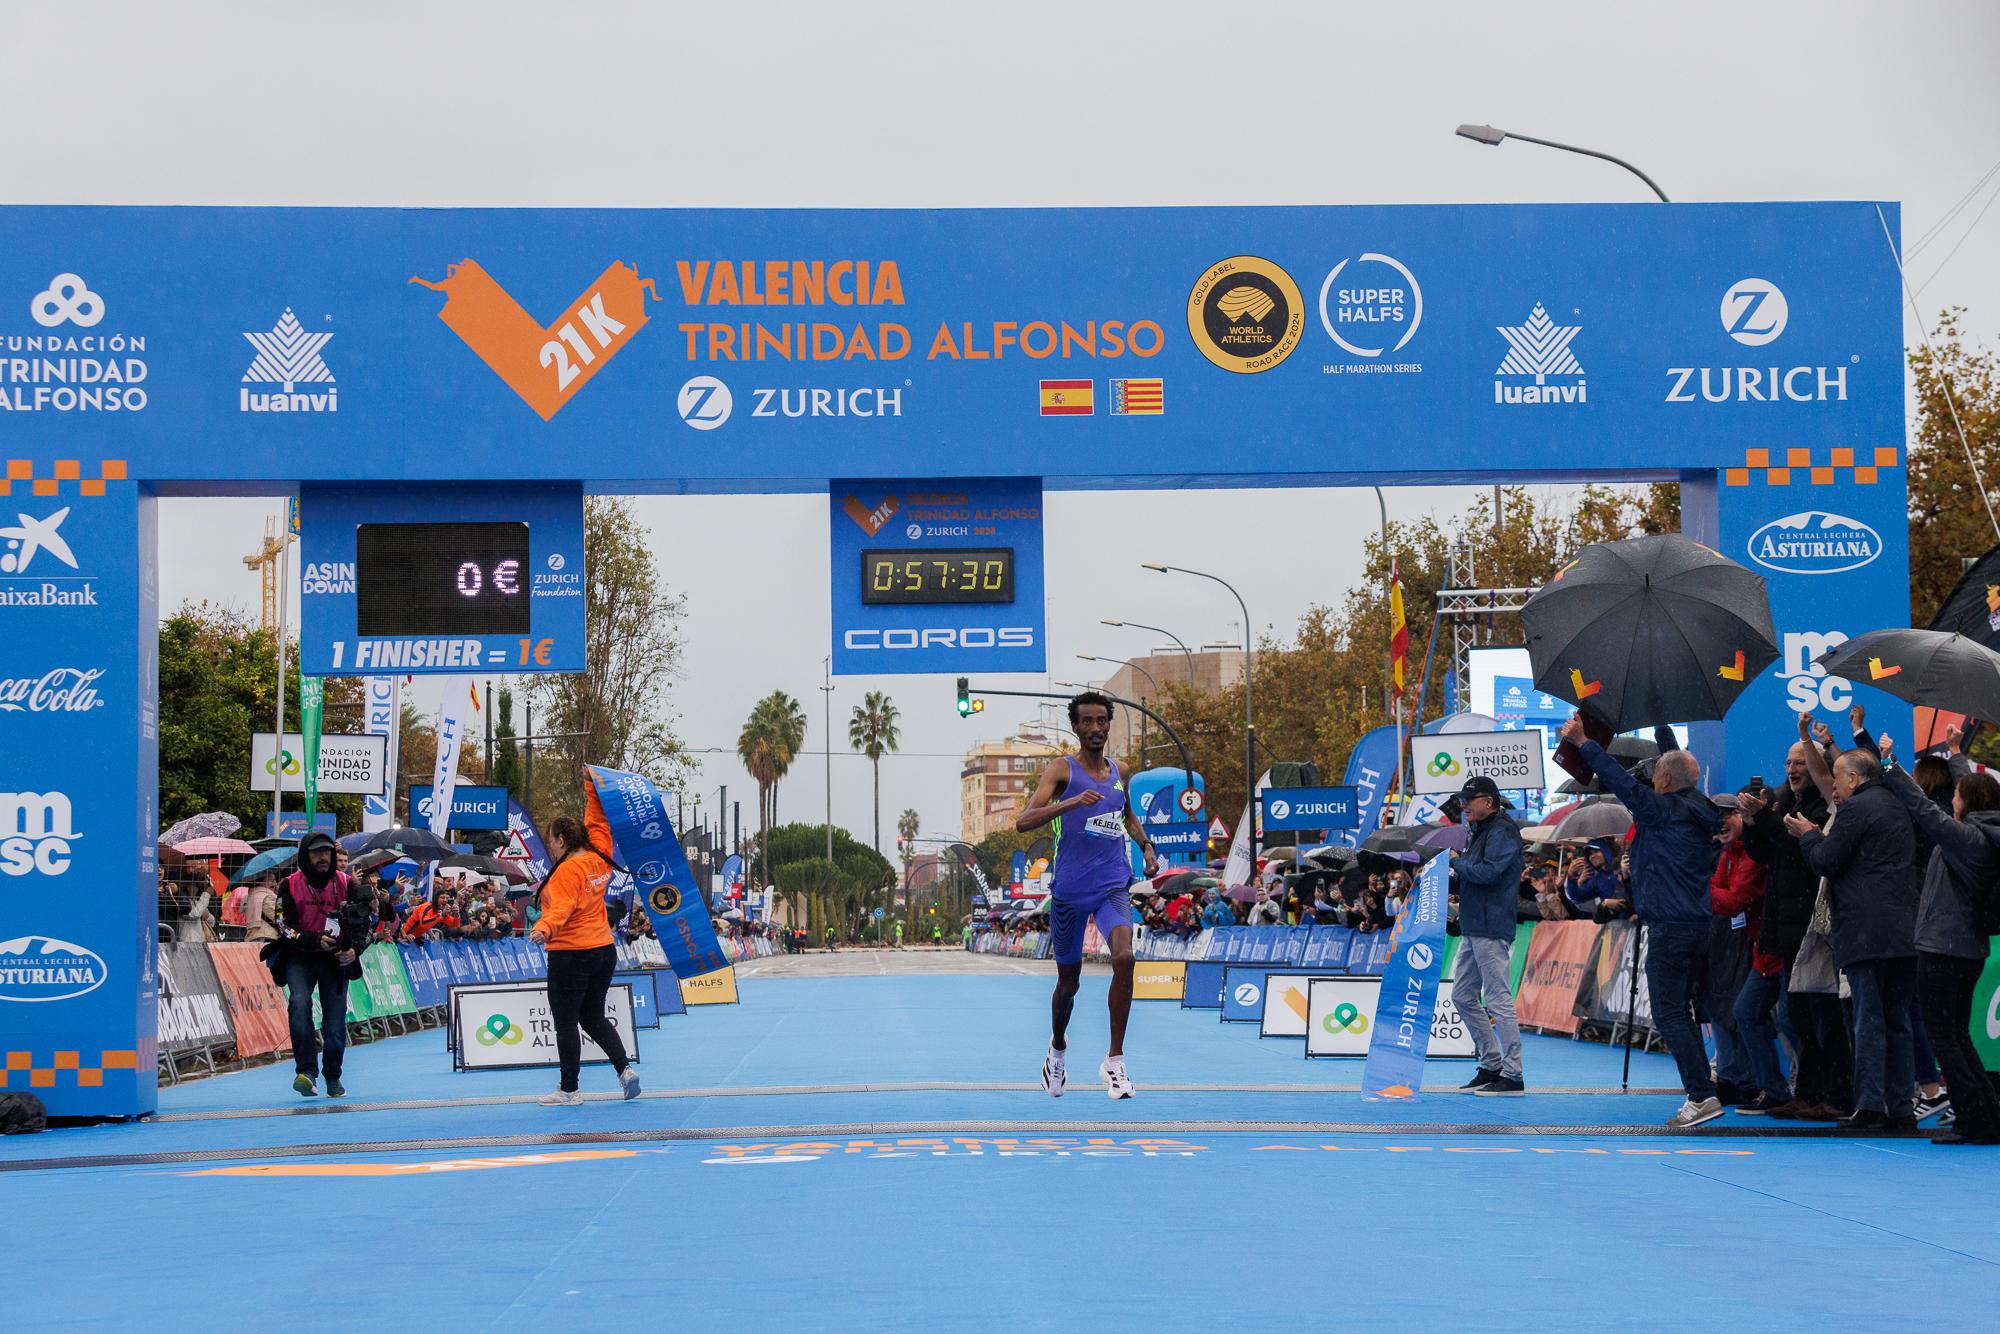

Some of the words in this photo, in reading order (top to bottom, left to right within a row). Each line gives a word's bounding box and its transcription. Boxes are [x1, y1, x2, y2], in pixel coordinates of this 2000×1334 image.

[676, 260, 905, 305] VALENCIA
[1193, 280, 1209, 306] GOLD
[1208, 262, 1236, 281] LABEL
[1338, 288, 1404, 305] SUPER
[1338, 306, 1404, 322] HALFS
[1229, 326, 1264, 335] WORLD
[538, 292, 627, 393] 21K
[678, 321, 911, 361] TRINIDAD
[927, 319, 1165, 359] ALFONSO
[1221, 335, 1273, 344] ATHLETICS
[1246, 356, 1272, 369] ROAD
[1272, 338, 1293, 360] RACE
[1289, 312, 1300, 336] 2024
[1323, 364, 1344, 374] HALF
[1346, 364, 1392, 374] MARATHON
[1394, 363, 1422, 373] SERIES
[1495, 380, 1586, 404] luanvi
[1665, 366, 1848, 402] ZURICH
[240, 387, 337, 412] luanvi
[751, 387, 901, 417] ZURICH
[869, 502, 895, 530] 21K
[907, 509, 970, 522] TRINIDAD
[973, 508, 1039, 521] ALFONSO
[926, 527, 968, 536] ZURICH
[1759, 535, 1872, 558] ASTURIANA
[303, 563, 355, 582] ASIN
[534, 573, 580, 584] ZURICH
[873, 561, 1003, 591] 0:57:30
[0, 583, 98, 606] aixaBank
[303, 580, 356, 594] DOWN
[531, 585, 582, 598] Foundation
[844, 627, 1034, 649] COROS
[332, 641, 345, 668] 1
[355, 639, 482, 668] FINISHER
[519, 638, 554, 666] 1€
[0, 668, 107, 712] ca-Cola
[321, 748, 371, 756] NDACIÓN
[1464, 744, 1527, 754] FUNDACIÓN
[317, 758, 371, 769] RINIDAD
[1464, 754, 1528, 767] TRINIDAD
[317, 770, 371, 781] FONSO
[1466, 766, 1529, 779] ALFONSO
[617, 779, 638, 826] FUNDACIÓN
[624, 776, 645, 824] TRINIDAD
[632, 774, 658, 820] ALFONSO
[448, 802, 496, 813] URICH
[1296, 802, 1347, 815] ZURICH
[1093, 818, 1121, 831] KEJELC
[1150, 832, 1187, 844] luanvi
[1421, 876, 1431, 922] TRINIDAD
[1430, 875, 1439, 923] FUNDACIÓN
[0, 957, 40, 965] ENTRAL
[44, 957, 90, 965] LECHERA
[0, 967, 96, 985] TURIANA
[683, 978, 724, 988] HALFS
[1137, 975, 1185, 984] SUPERHA
[1397, 977, 1423, 1049] ZURICH
[712, 1138, 1191, 1151] VALENCIA
[1249, 1144, 1756, 1157] ALFONSO
